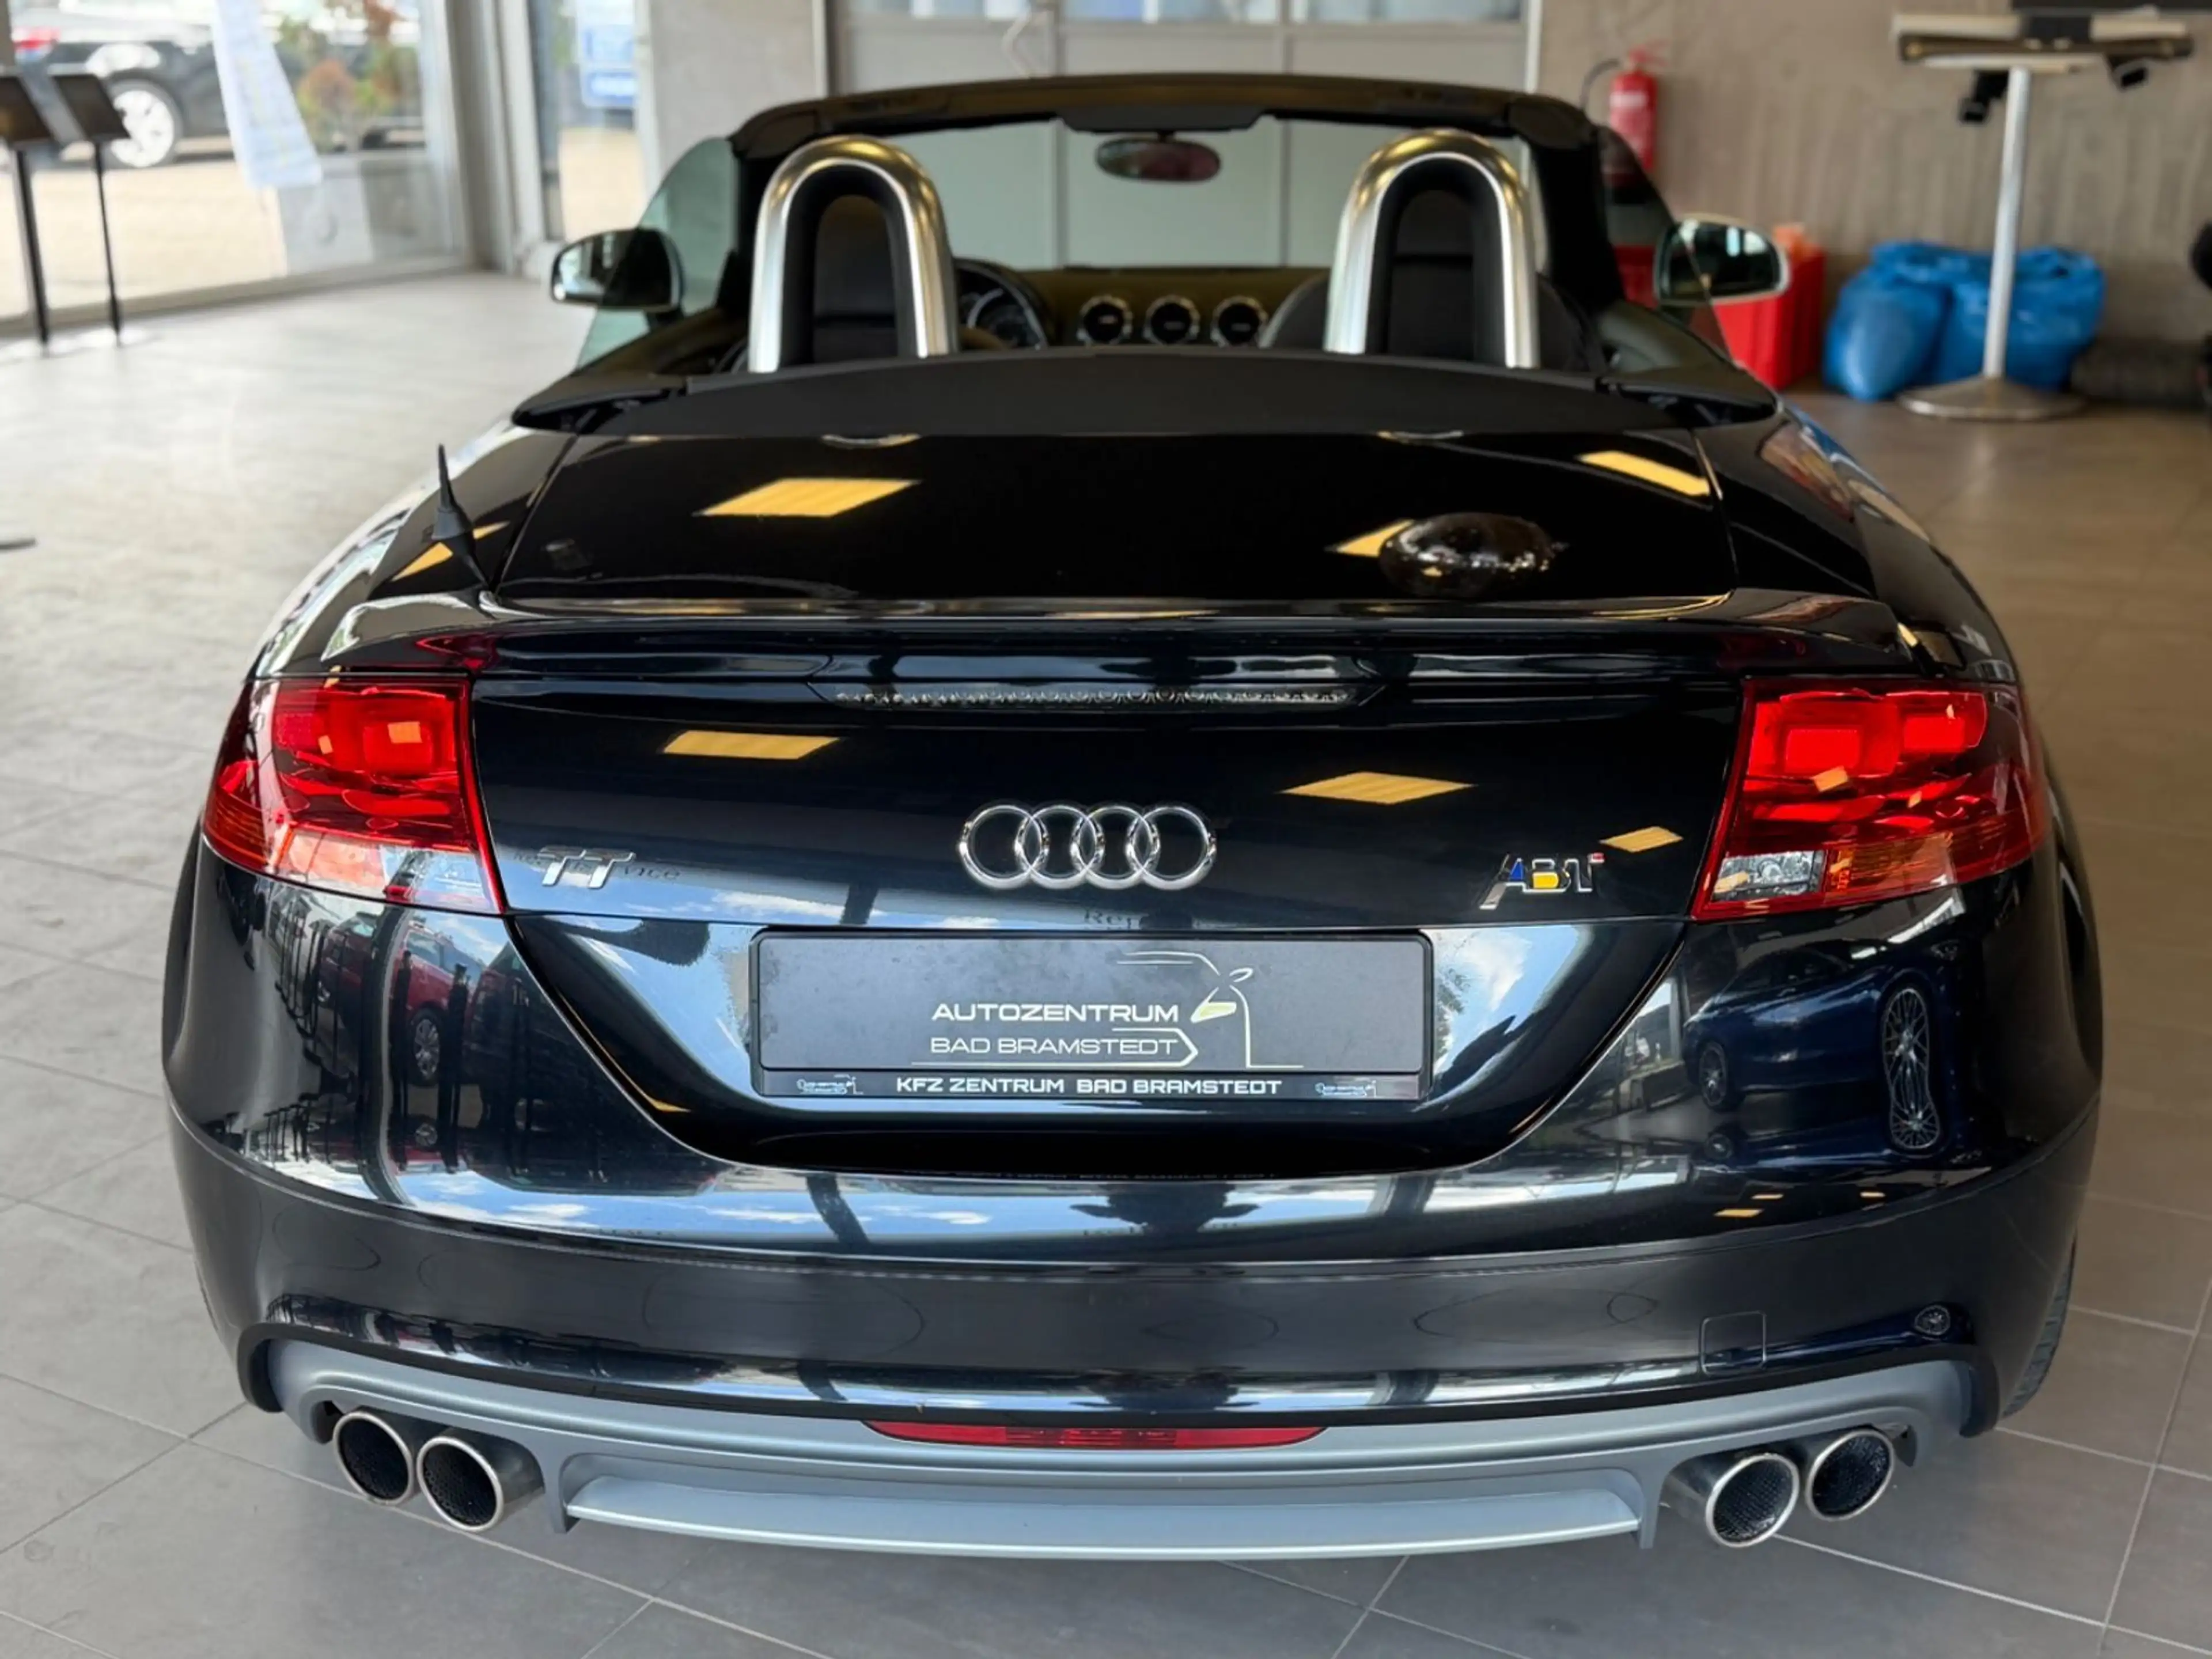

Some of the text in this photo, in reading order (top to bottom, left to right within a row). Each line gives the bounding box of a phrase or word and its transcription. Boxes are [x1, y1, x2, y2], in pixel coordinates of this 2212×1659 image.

[536, 844, 637, 889] TT
[1479, 853, 1605, 910] ABT
[931, 1003, 1179, 1022] AUTOZENTRUM
[930, 1037, 1179, 1056] BAD BRAMSTEDT
[896, 1077, 1282, 1094] KFZ ZENTRUM BAD BRAMSTEDT
